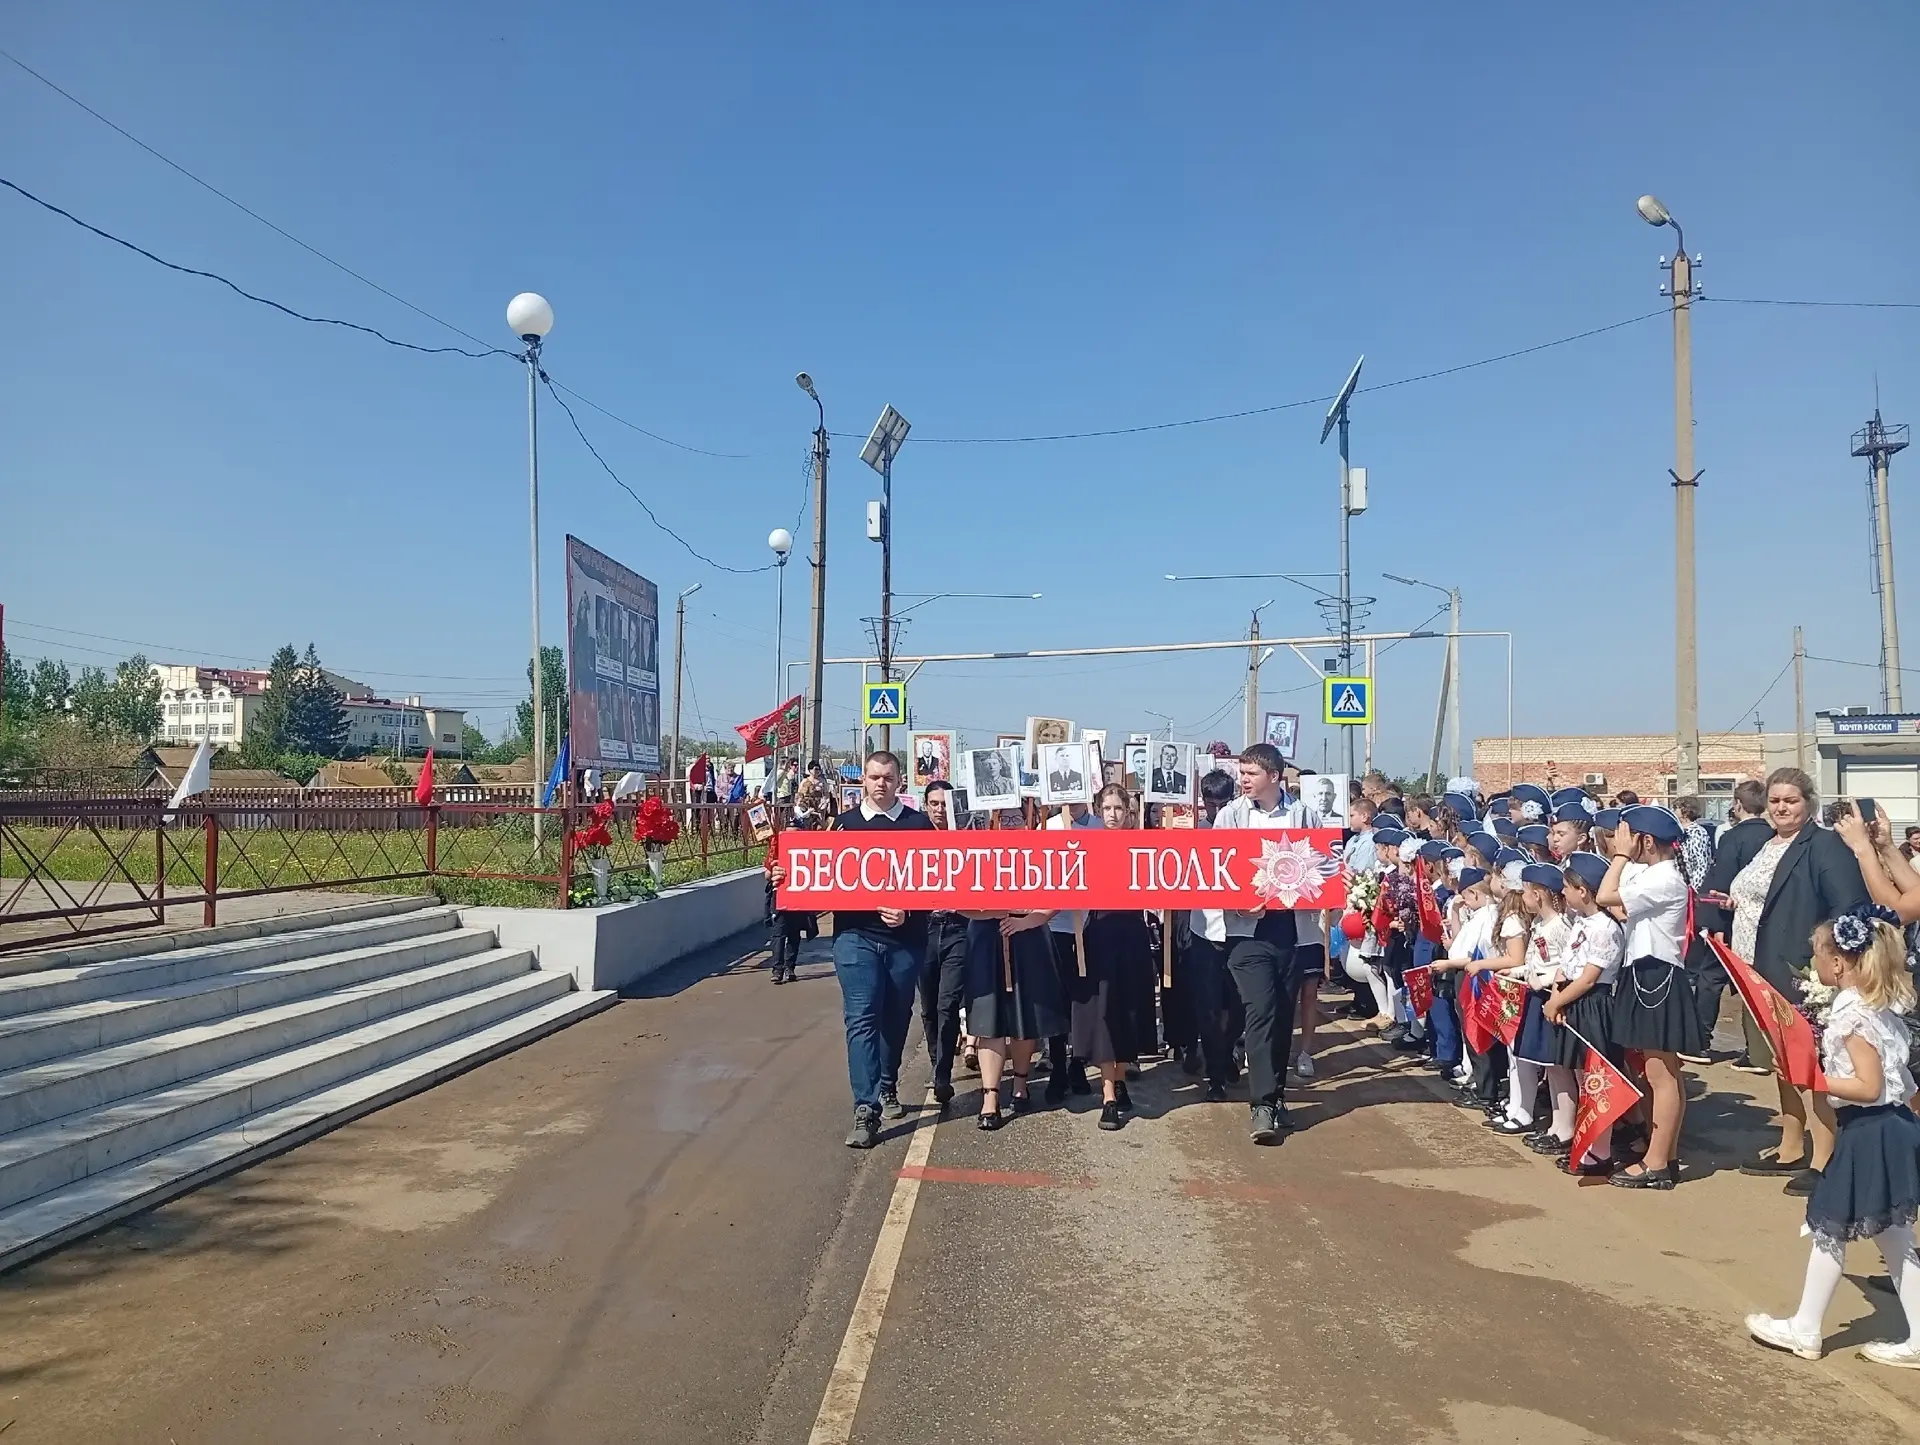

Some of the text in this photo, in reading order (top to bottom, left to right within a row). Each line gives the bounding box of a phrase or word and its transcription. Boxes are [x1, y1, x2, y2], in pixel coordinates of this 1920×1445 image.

[1839, 723, 1892, 731] ПОЧТА РОССИИ
[786, 840, 1241, 892] БЕССМЕРТНЫЙ ПОЛК
